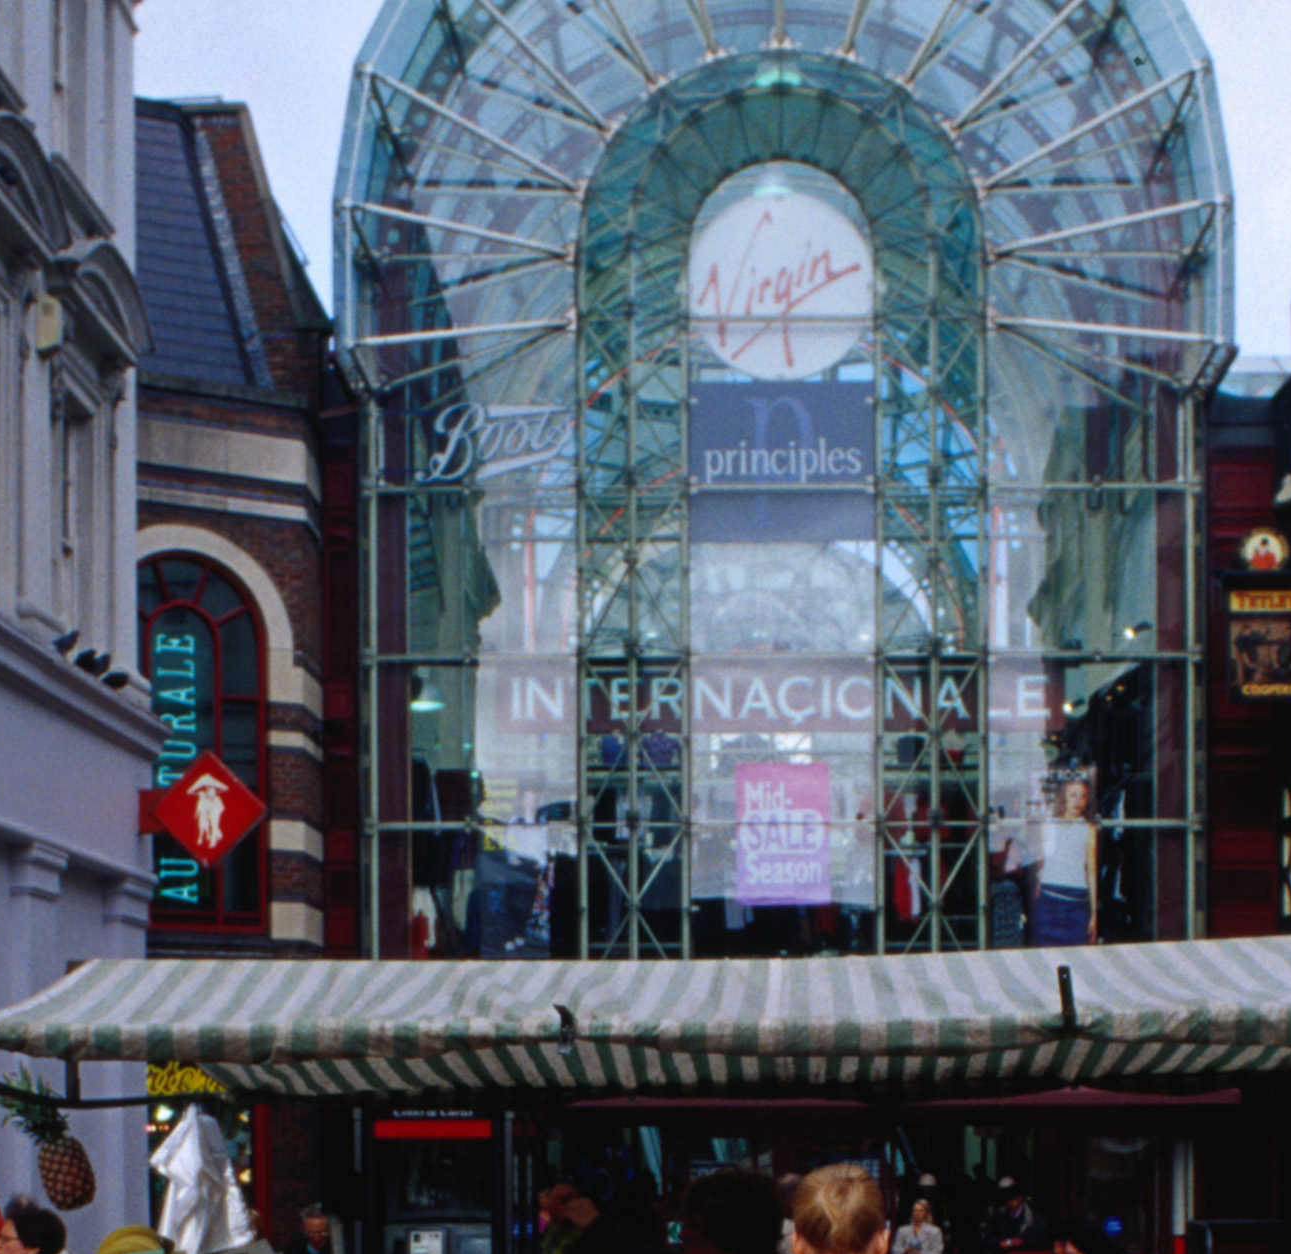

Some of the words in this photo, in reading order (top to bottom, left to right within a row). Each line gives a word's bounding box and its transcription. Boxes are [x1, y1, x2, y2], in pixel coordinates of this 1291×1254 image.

[697, 209, 859, 366] Virgin
[414, 402, 576, 484] Boots
[705, 441, 861, 483] principles
[156, 634, 198, 788] TURALE
[745, 781, 793, 810] Mid-
[747, 814, 817, 850] SALE
[745, 854, 822, 884] Season
